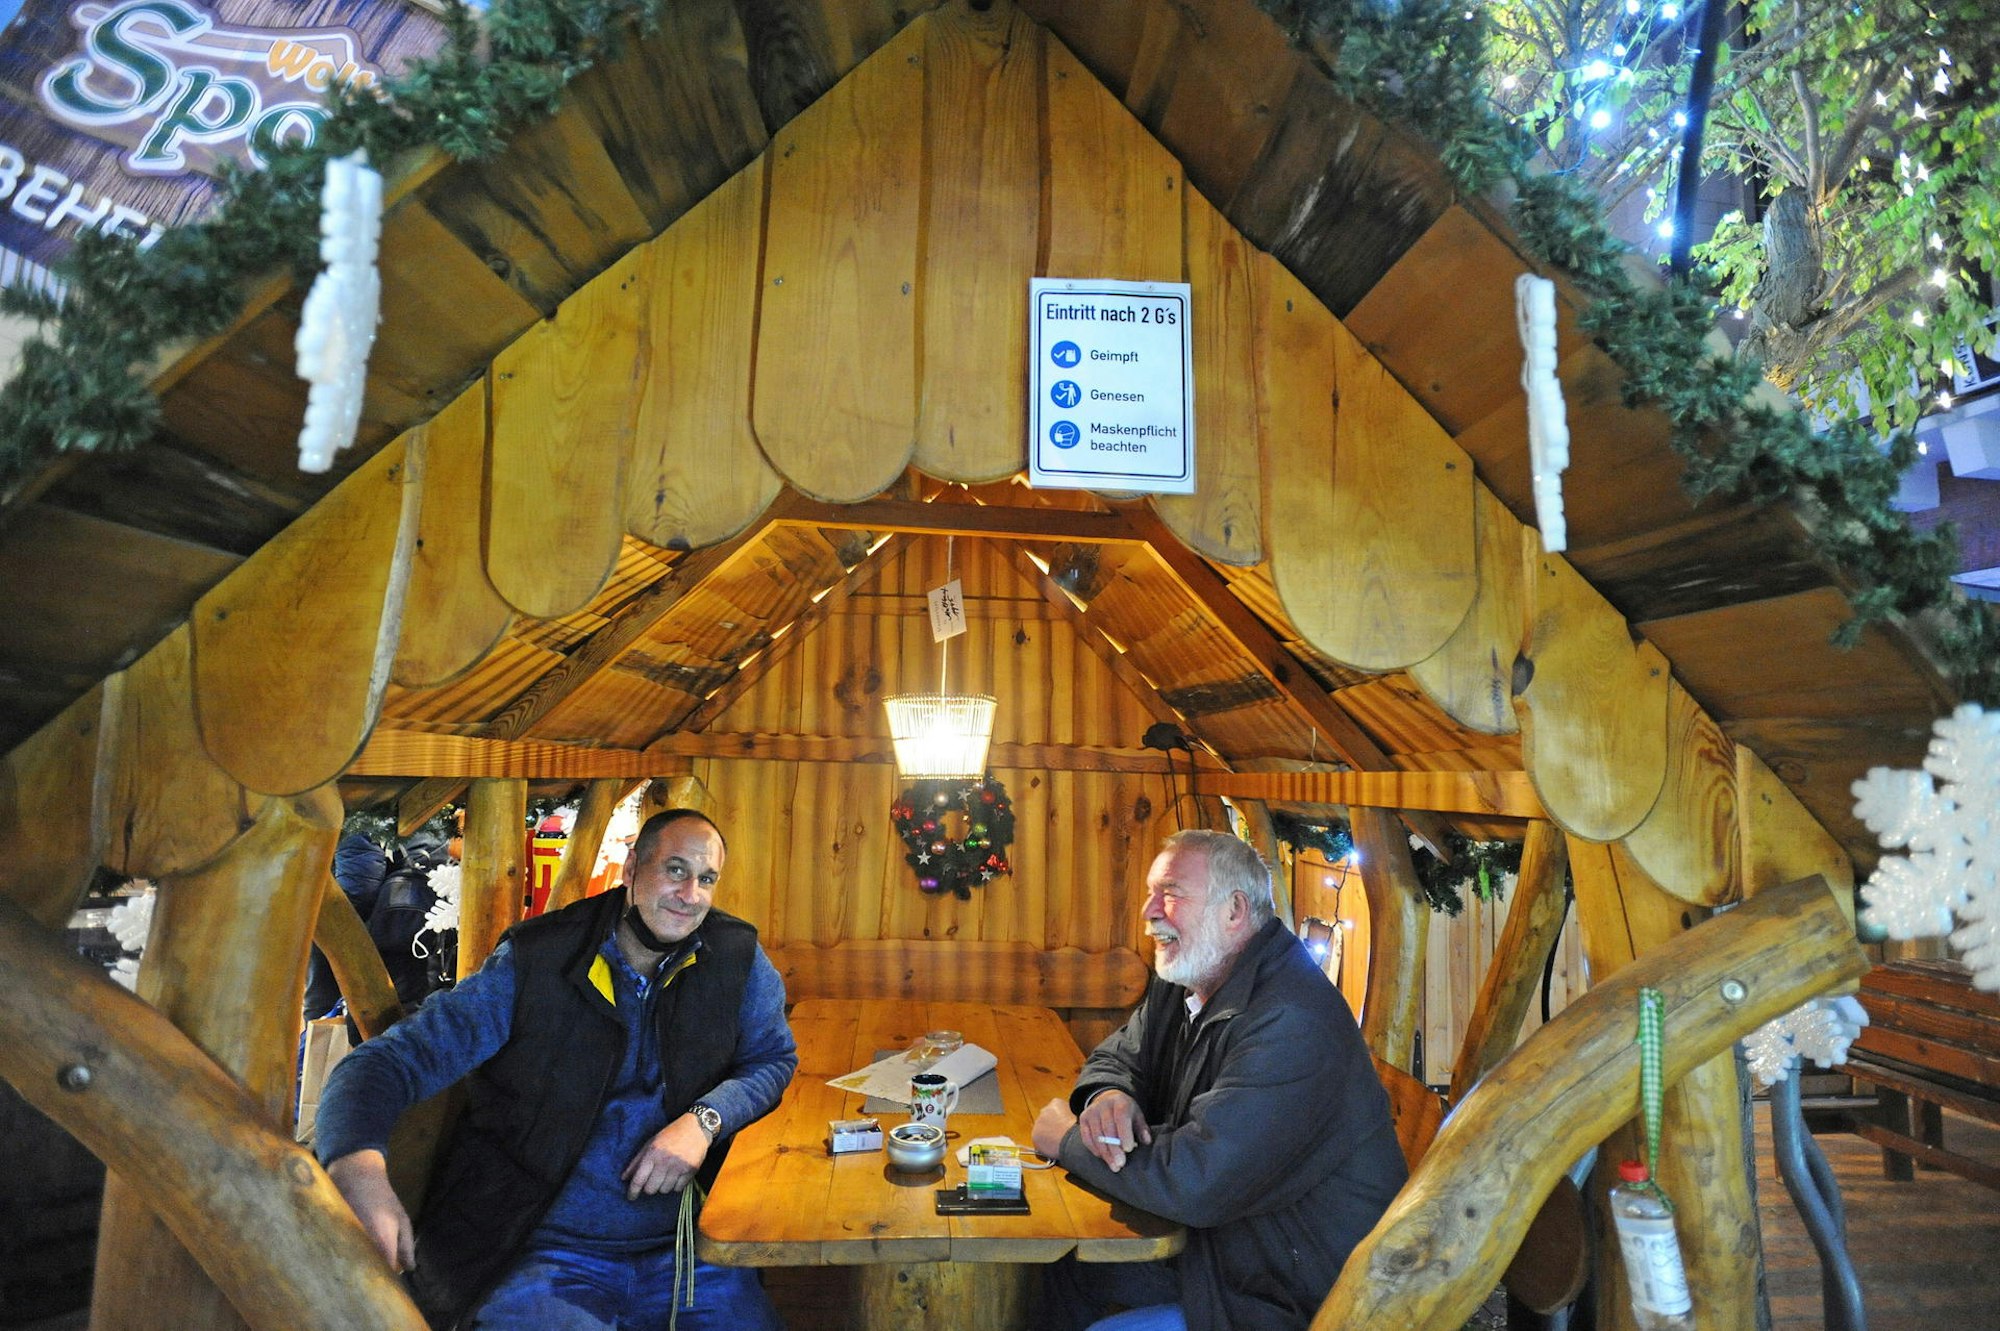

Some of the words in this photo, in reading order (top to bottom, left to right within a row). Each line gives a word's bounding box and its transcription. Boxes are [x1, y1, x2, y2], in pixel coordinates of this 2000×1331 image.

[42, 0, 335, 172] Spo
[1046, 303, 1097, 321] Eintritt
[1100, 306, 1136, 323] nach
[1141, 306, 1150, 324] 2
[1090, 349, 1139, 364] Geimpft
[1090, 389, 1145, 403] Genesen
[1090, 423, 1177, 438] Maskenpflicht
[1090, 440, 1147, 454] beachten
